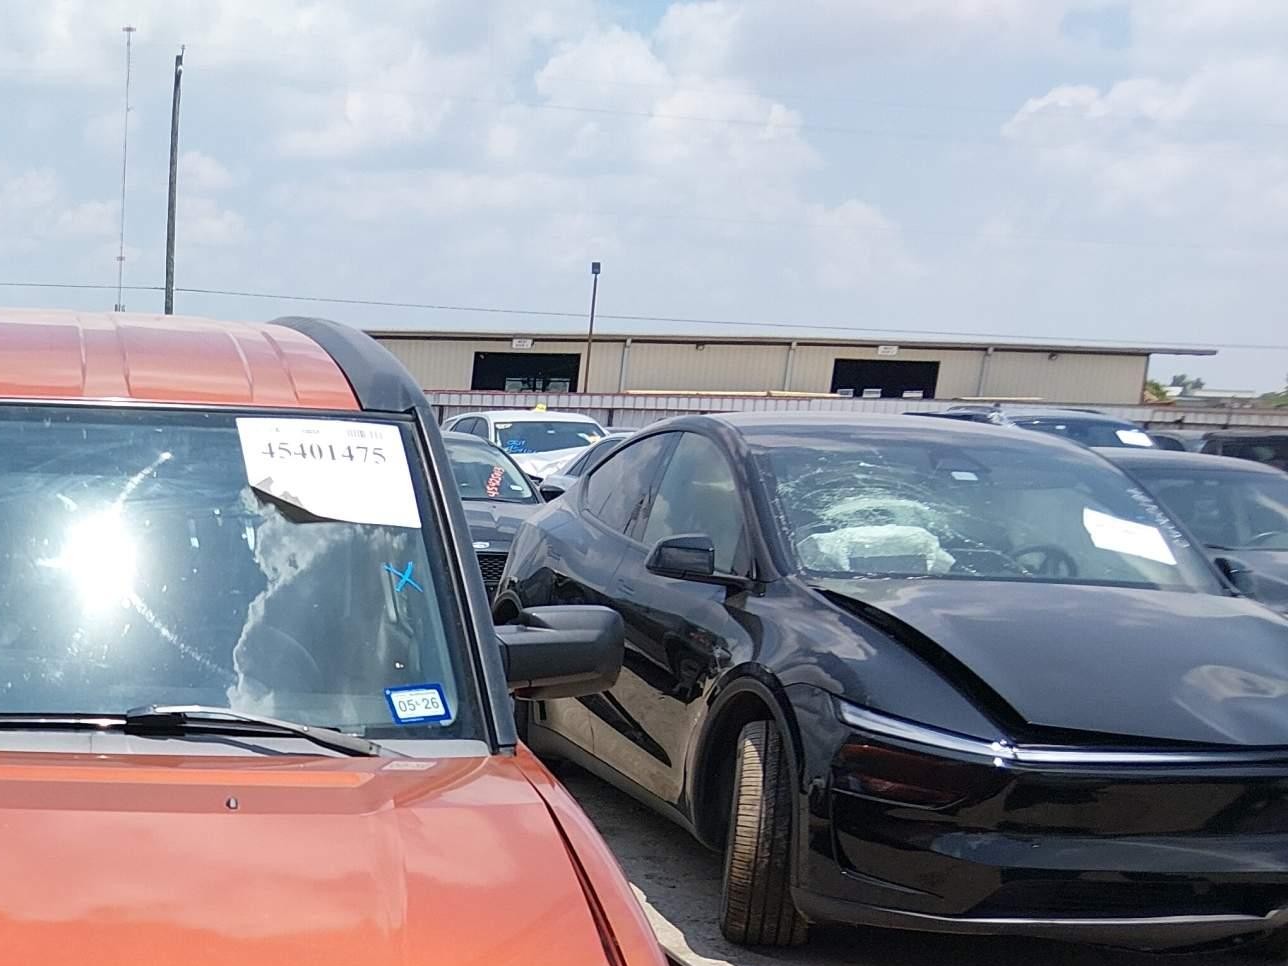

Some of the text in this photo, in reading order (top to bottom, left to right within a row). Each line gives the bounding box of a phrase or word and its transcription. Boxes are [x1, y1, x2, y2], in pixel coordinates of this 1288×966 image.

[261, 442, 387, 465] 45401475
[398, 697, 440, 712] 05 26
